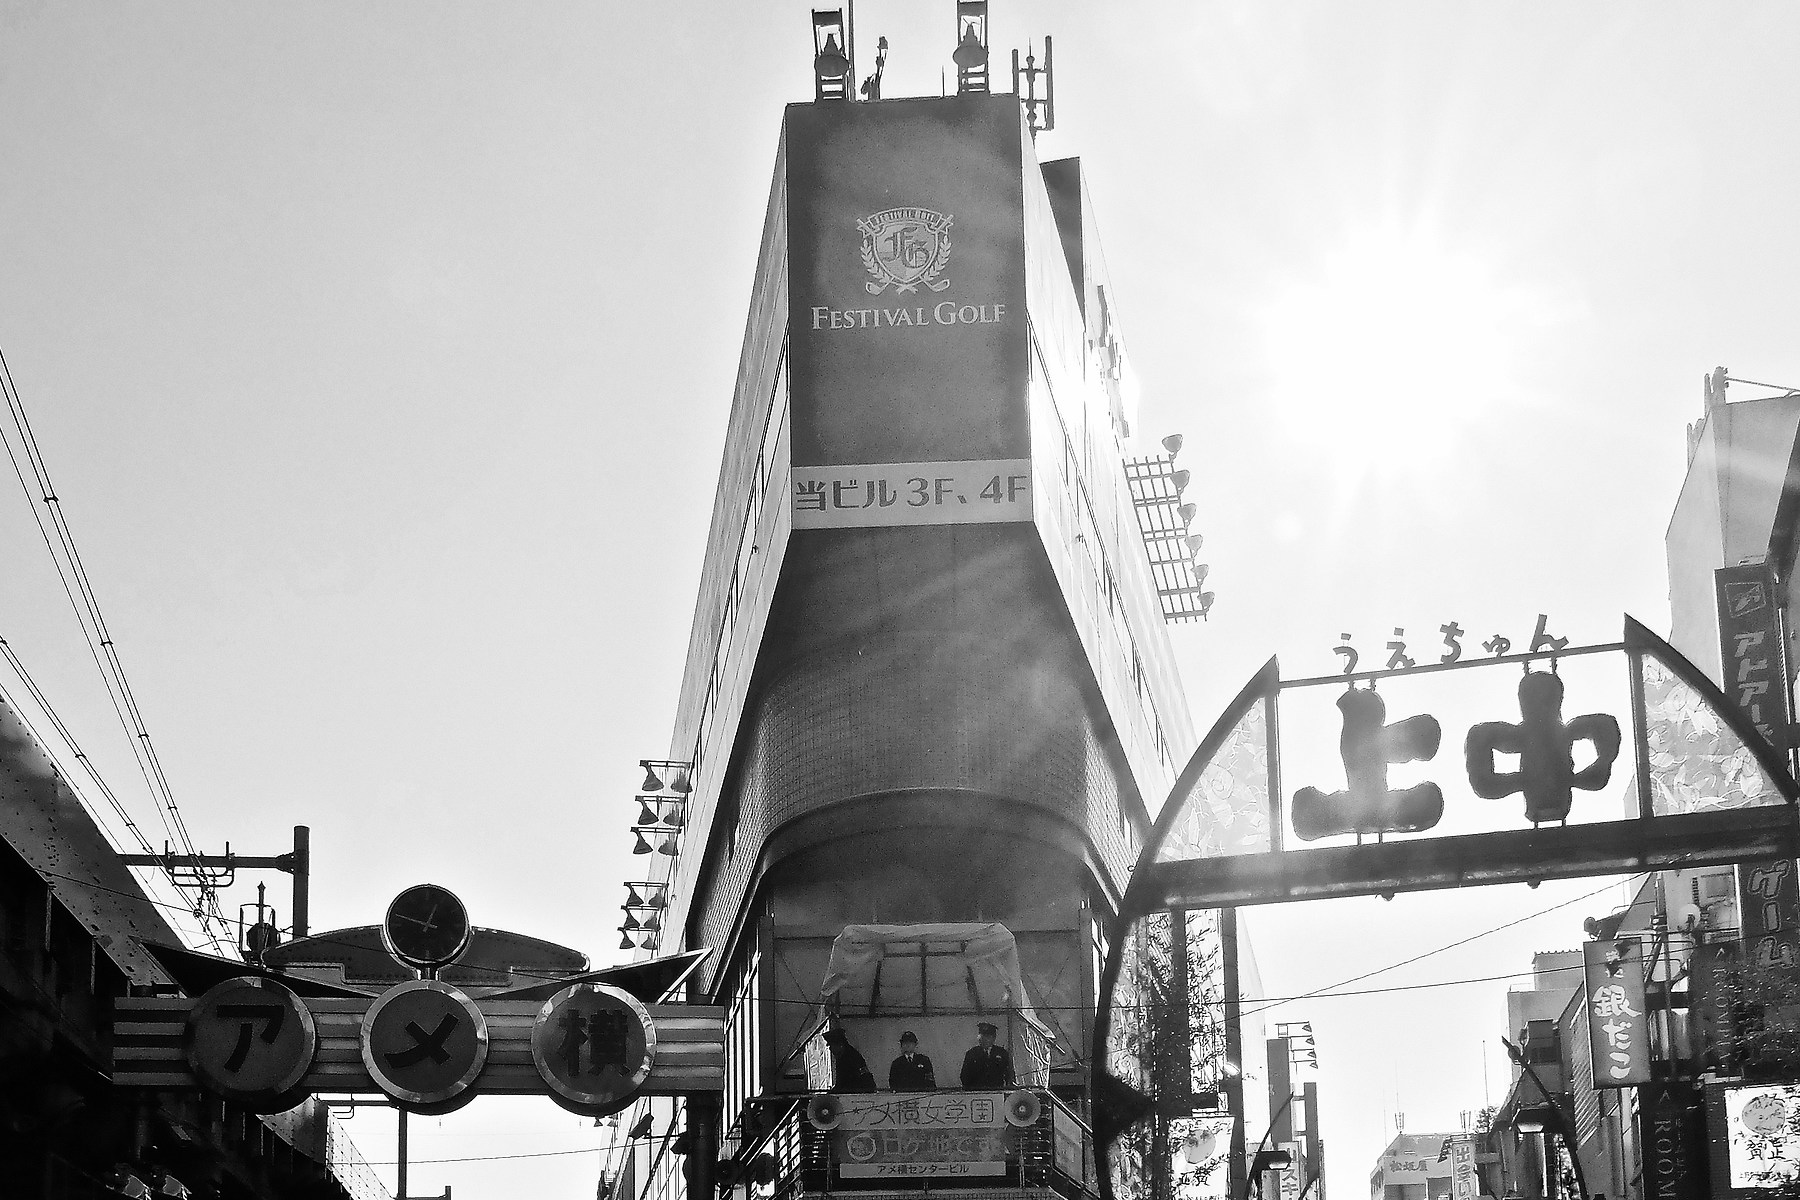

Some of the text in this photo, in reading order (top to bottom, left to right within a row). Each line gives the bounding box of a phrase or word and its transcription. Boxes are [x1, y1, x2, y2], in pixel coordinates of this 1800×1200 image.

[811, 301, 1007, 330] FESTIVAL GOLF
[1333, 614, 1569, 674] うえちゅん
[1291, 671, 1621, 841] 上中
[216, 1004, 631, 1077] アメ横
[1592, 985, 1643, 1080] 銀だこ
[877, 1164, 970, 1176] アメ横センタービル
